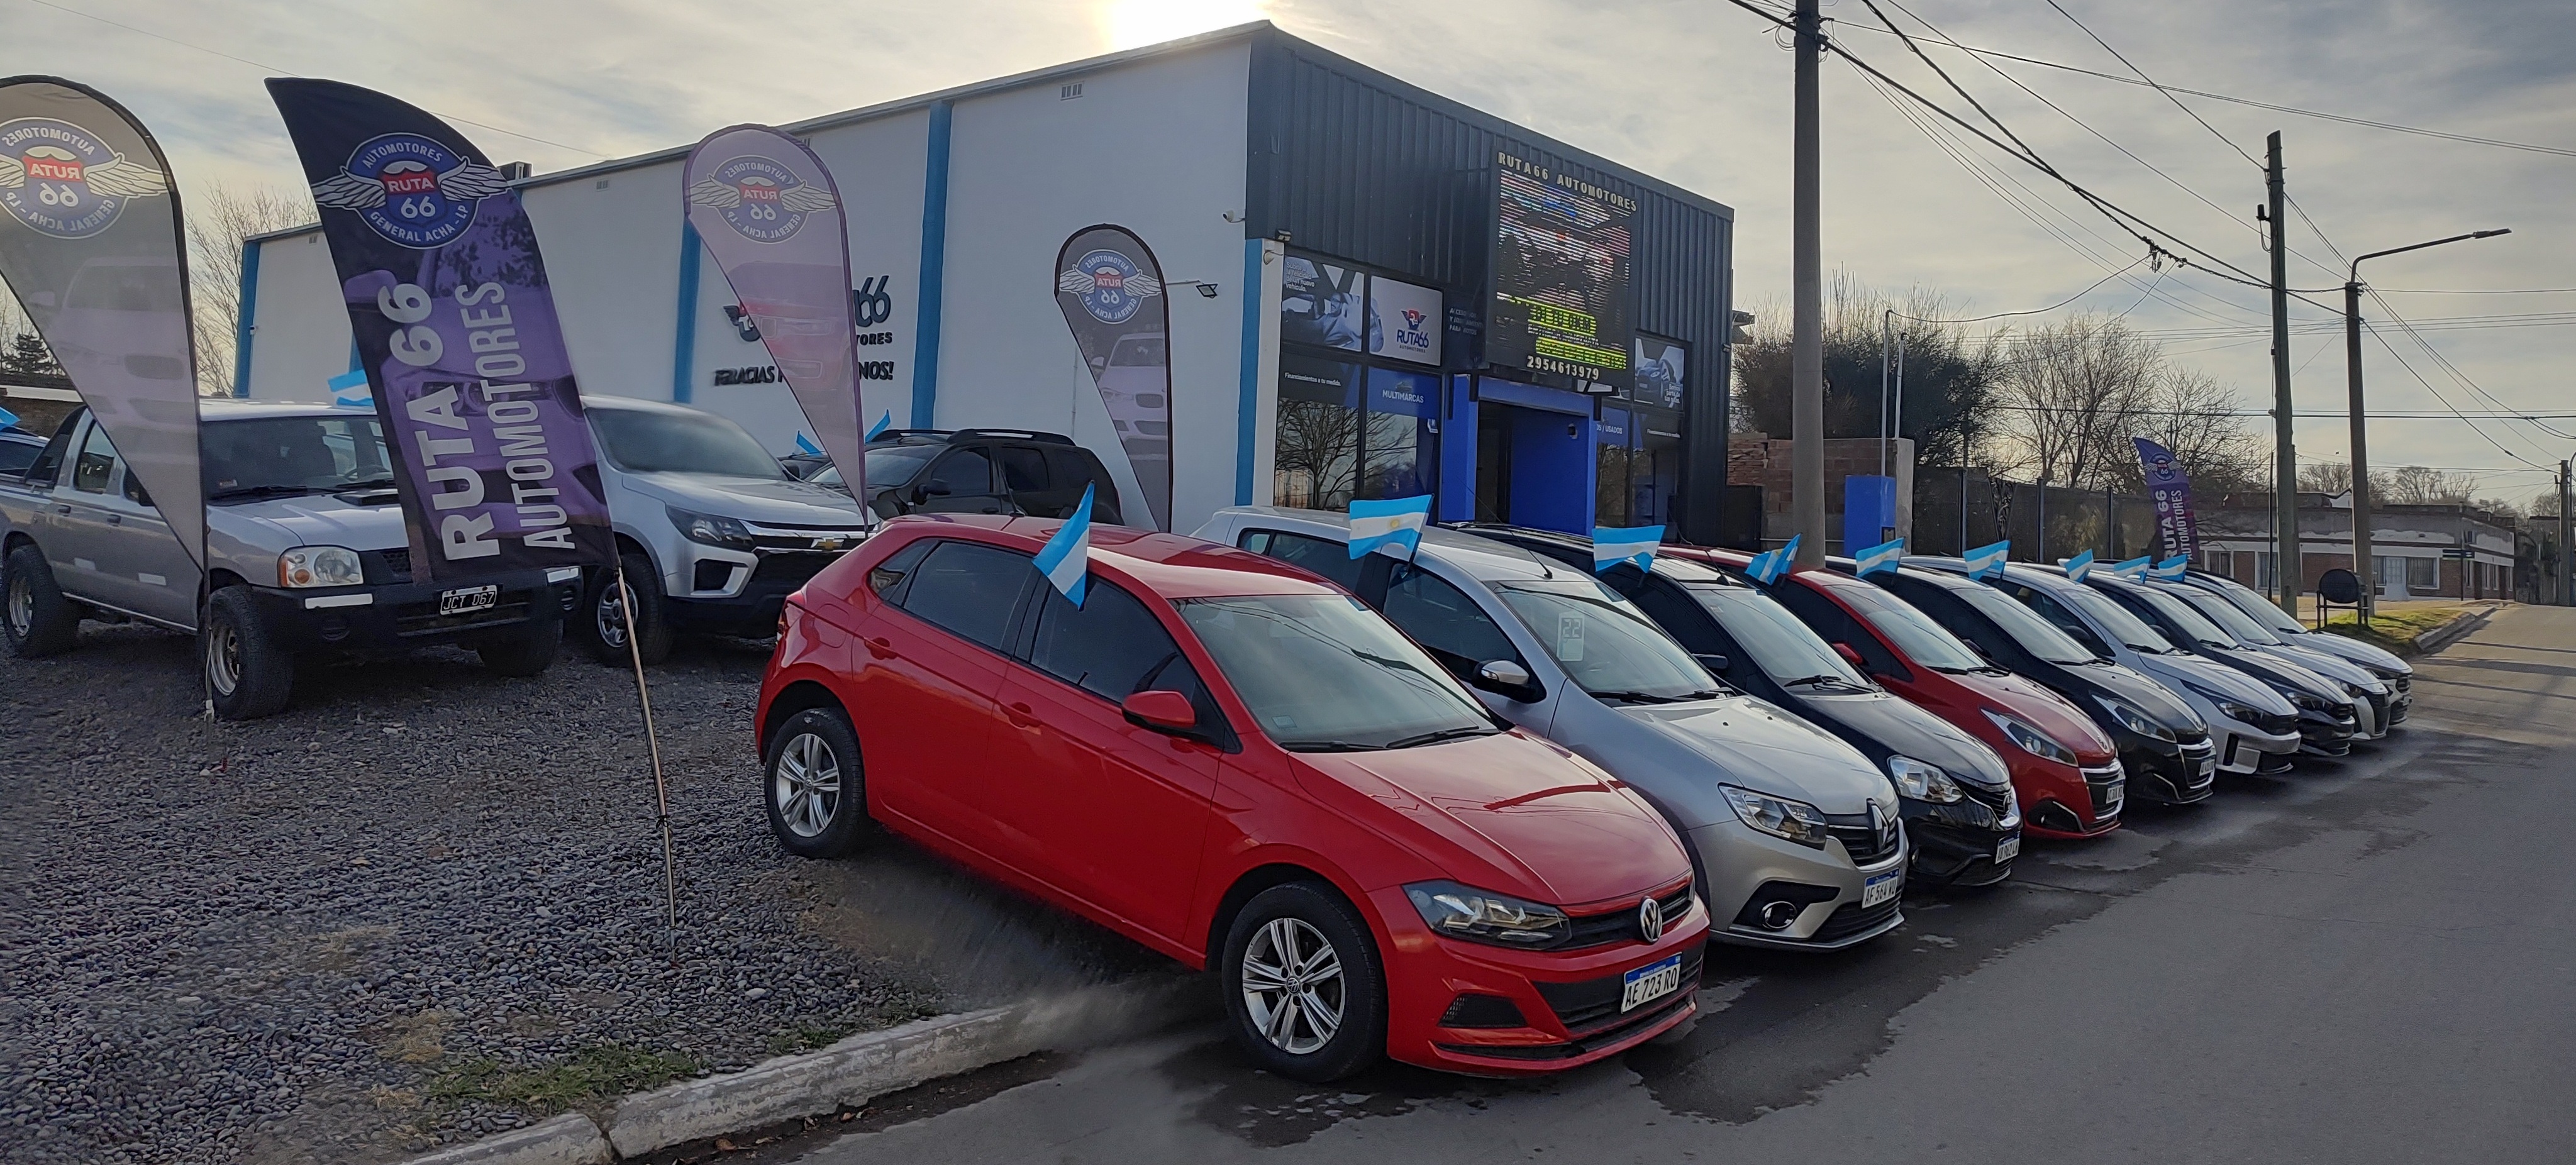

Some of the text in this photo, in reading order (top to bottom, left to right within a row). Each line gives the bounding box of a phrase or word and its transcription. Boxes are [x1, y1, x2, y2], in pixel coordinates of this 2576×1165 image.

[362, 142, 443, 169] AUTOMOTORES
[387, 178, 435, 192] RUTA
[1497, 152, 1637, 212] RUTA66 AUTOMOTORES
[401, 196, 436, 219] 66
[370, 211, 421, 241] GENERAL
[425, 223, 456, 241] ACHA
[455, 204, 469, 219] LP
[1397, 329, 1429, 348] RUTA66
[1526, 355, 1599, 380] 2954613979
[1382, 389, 1424, 404] MULTIMARCAS
[378, 283, 501, 561] RUTA 66
[455, 282, 576, 549] AUTOMOTORES
[1605, 425, 1623, 434] USADOS
[2155, 490, 2169, 512] 66
[2170, 490, 2193, 560] AUTOMOTORES
[2161, 516, 2177, 561] RUTA
[443, 592, 495, 610] JCT 067
[1562, 619, 1581, 638] 22
[1865, 887, 1875, 905] AF
[1625, 982, 1640, 1008] AE
[1641, 973, 1662, 1001] 723
[1663, 967, 1677, 991] RO
